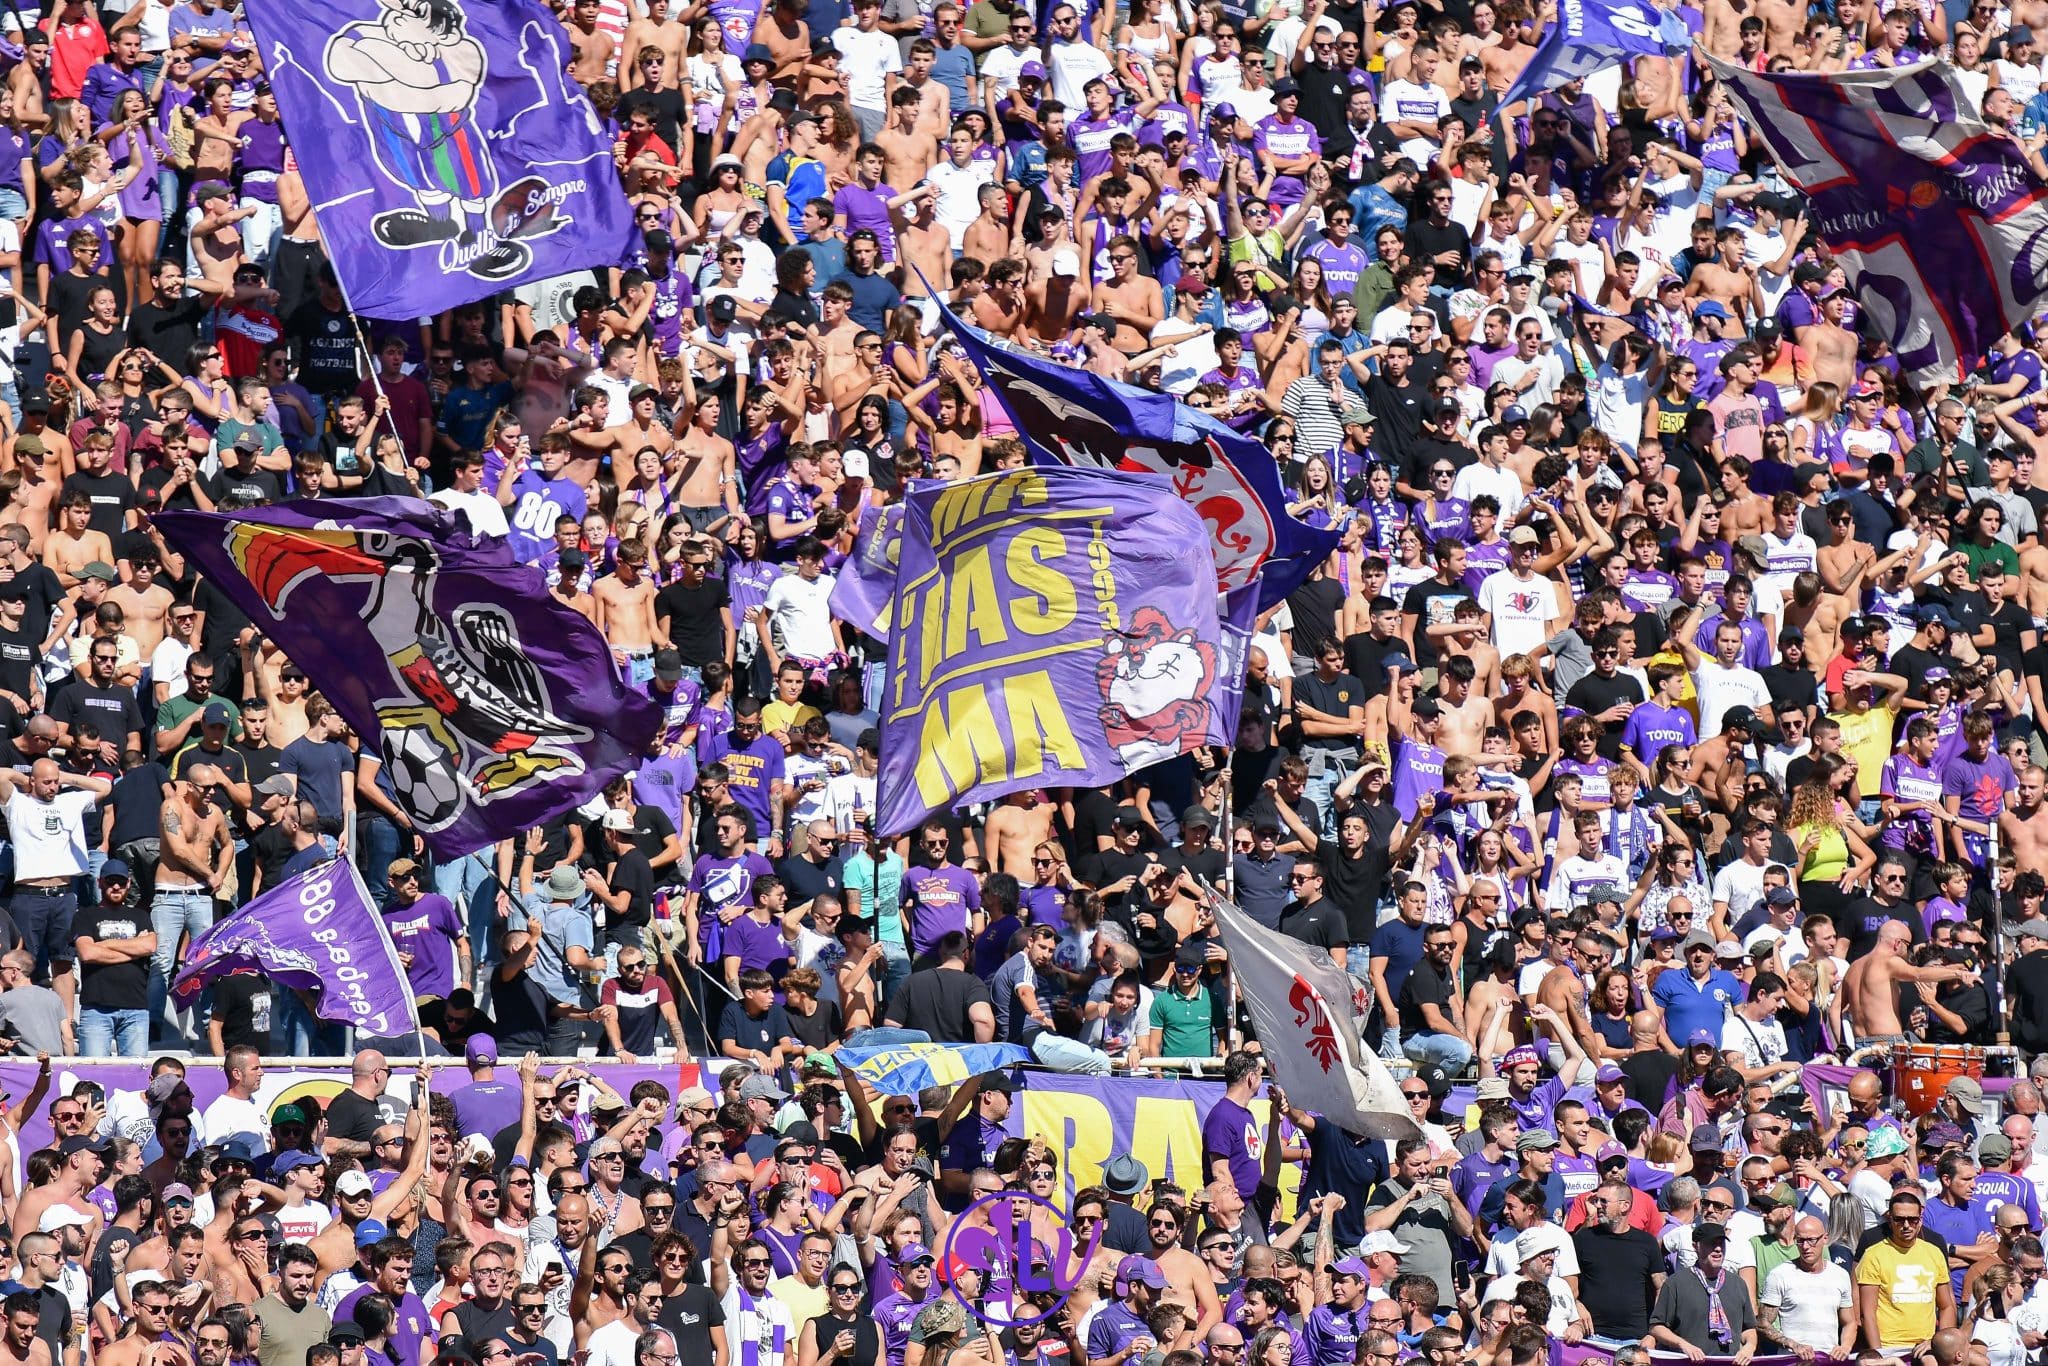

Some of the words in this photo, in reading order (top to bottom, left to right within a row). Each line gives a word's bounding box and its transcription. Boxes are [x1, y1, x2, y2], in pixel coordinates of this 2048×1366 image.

[524, 178, 587, 217] Sempre
[439, 226, 497, 274] Quelli
[310, 358, 355, 369] FOOTBALL
[514, 494, 561, 540] 80
[1089, 520, 1121, 631] 1993
[1769, 560, 1808, 570] Mediacom
[914, 671, 1087, 810] MA
